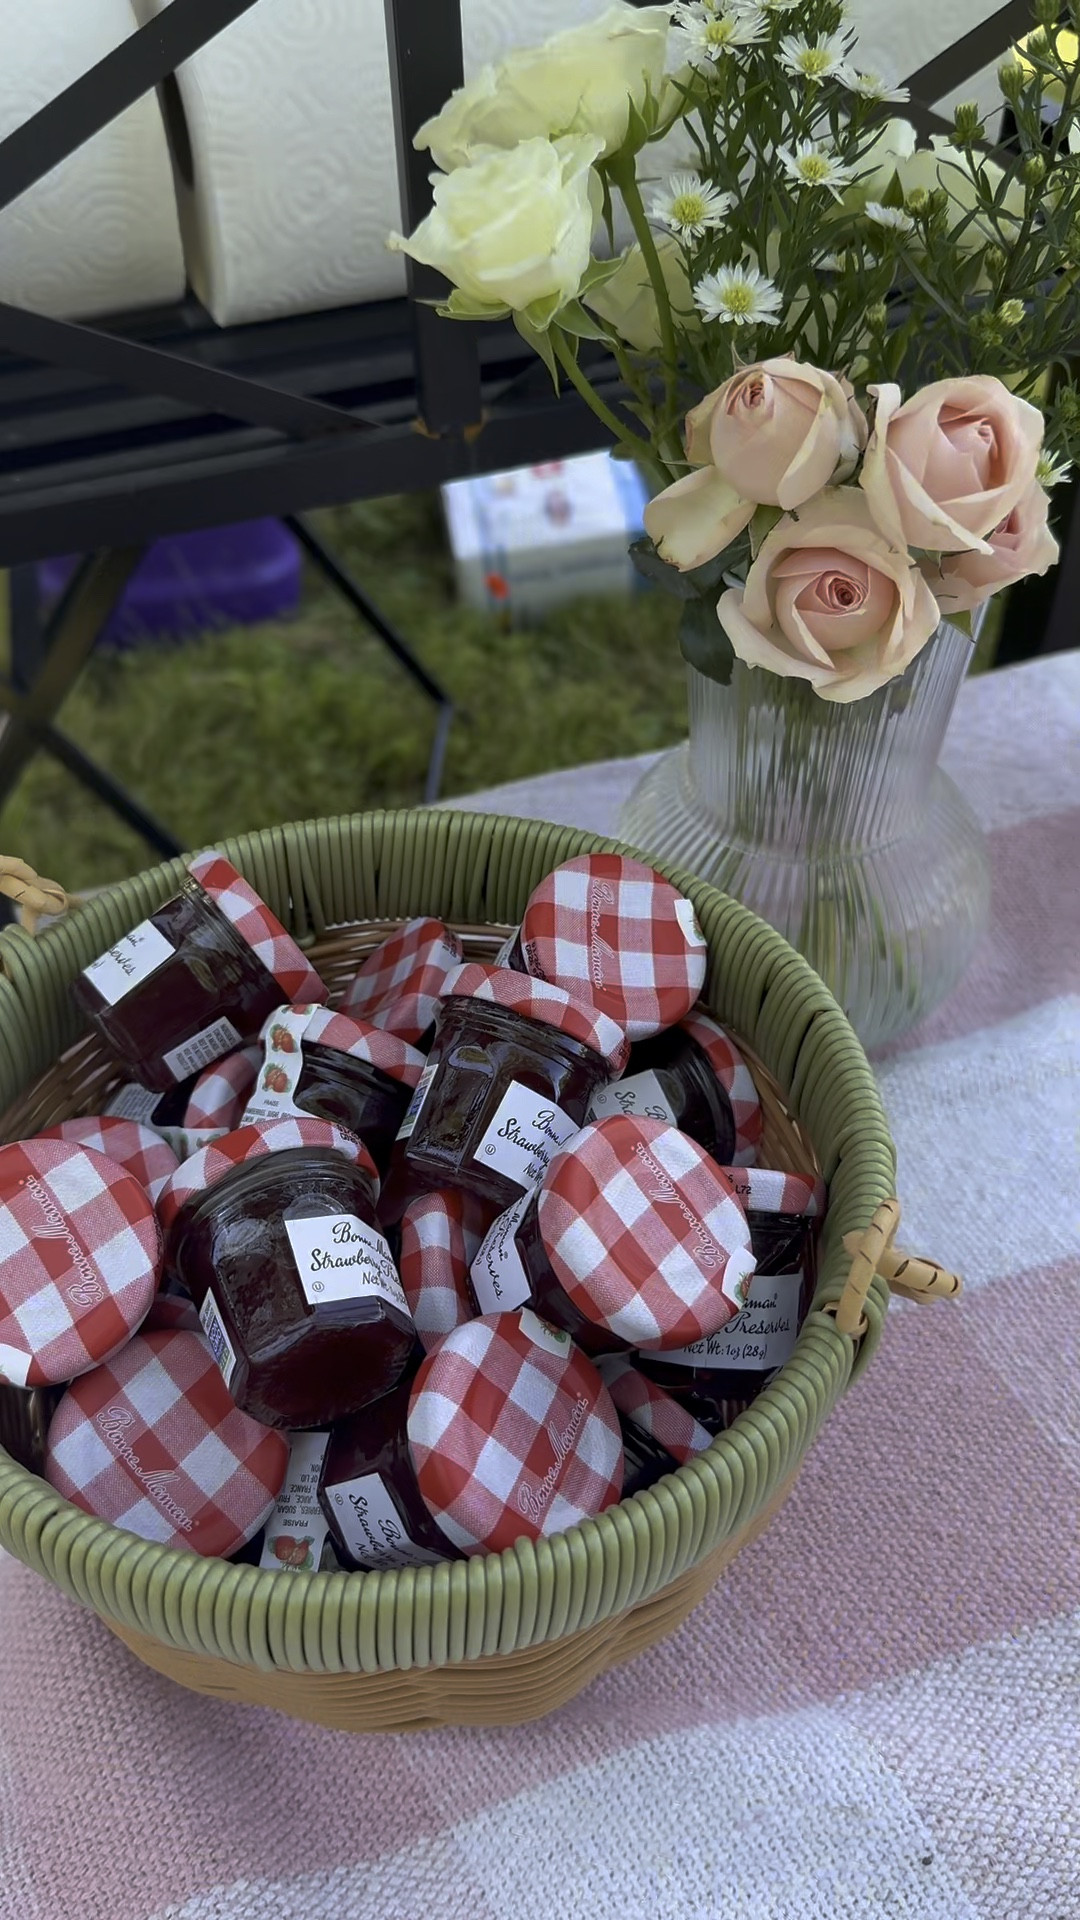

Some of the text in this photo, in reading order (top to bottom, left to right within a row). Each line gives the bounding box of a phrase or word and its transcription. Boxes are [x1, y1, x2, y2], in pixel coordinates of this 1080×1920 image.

[636, 1142, 685, 1211] Maman
[683, 1207, 725, 1267] Bonne
[26, 1174, 103, 1306] Bonne Maman
[97, 1405, 192, 1532] Bonne Maman
[518, 1398, 589, 1523] Bonne Maman
